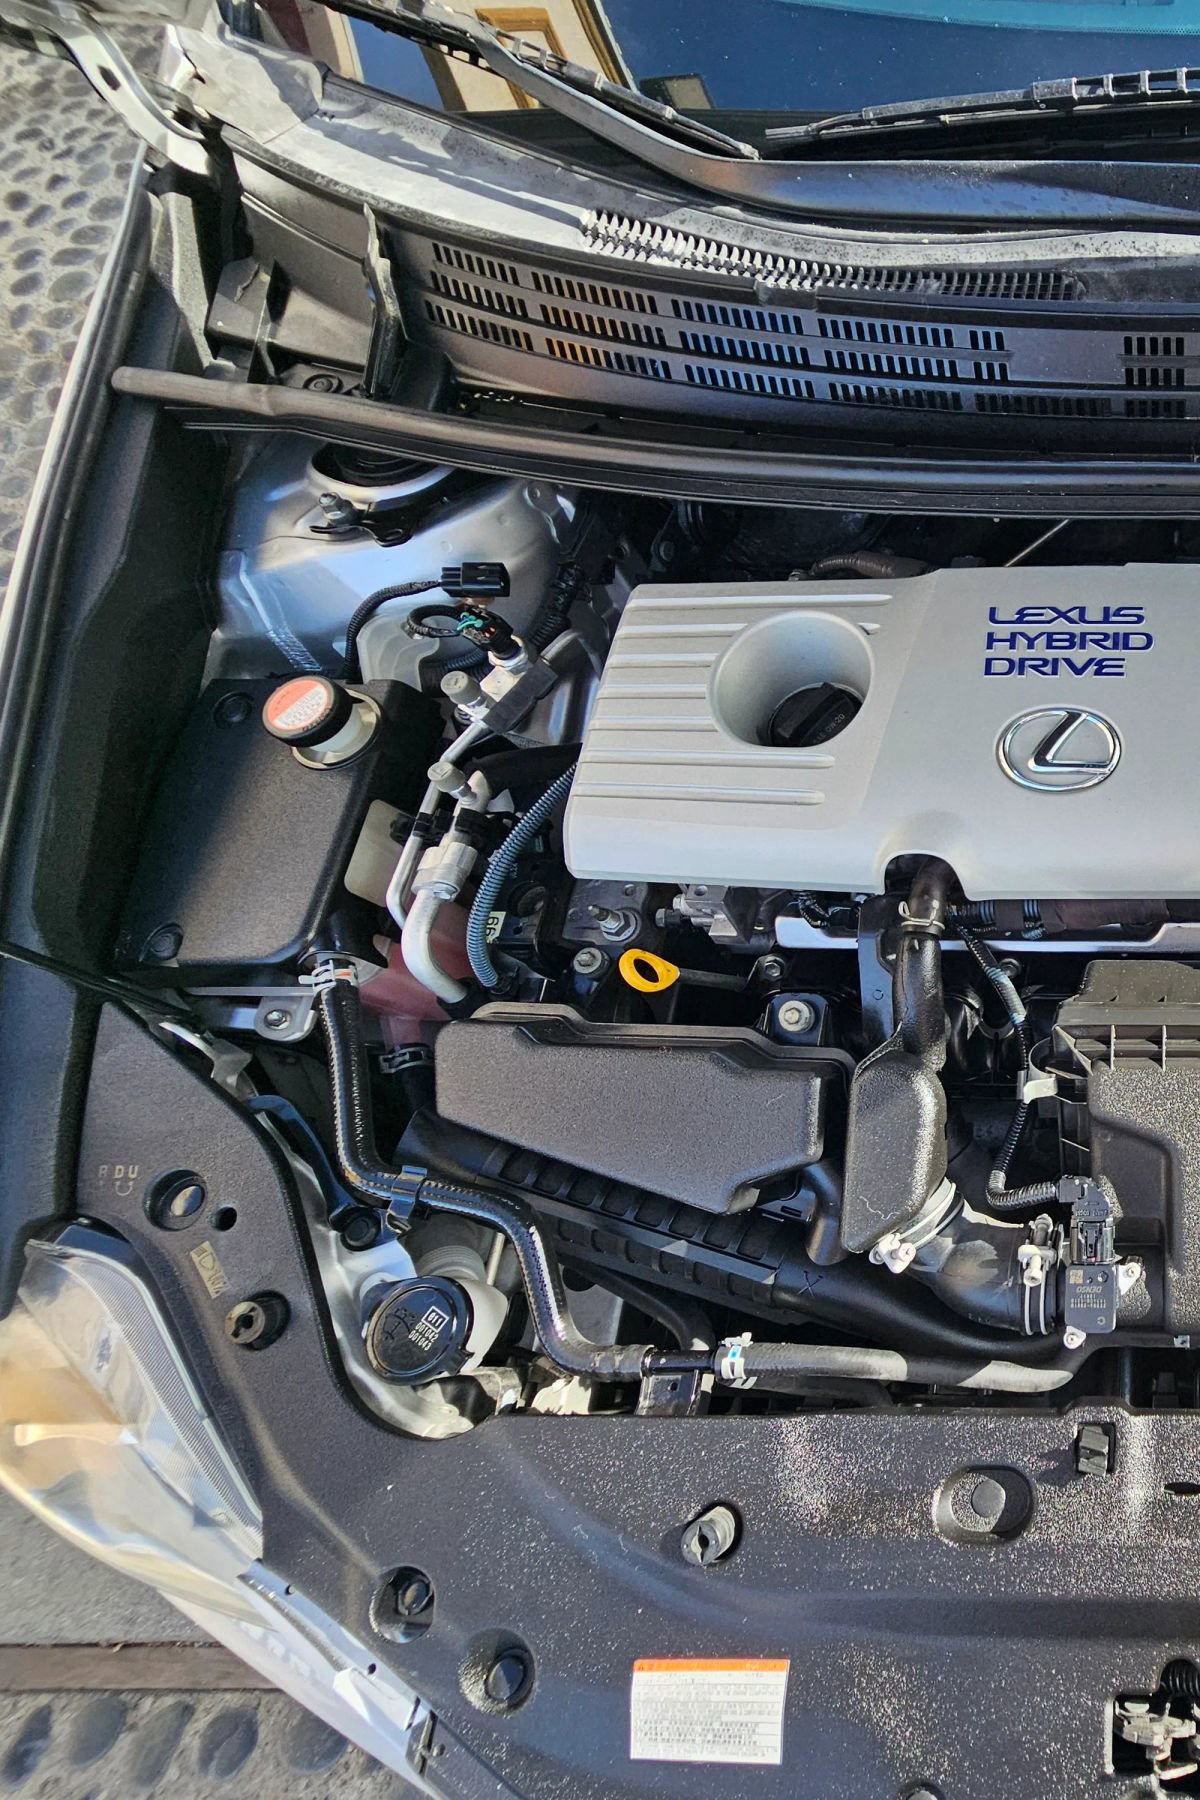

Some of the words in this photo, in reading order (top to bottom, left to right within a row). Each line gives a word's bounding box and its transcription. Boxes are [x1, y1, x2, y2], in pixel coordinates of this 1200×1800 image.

[988, 606, 1145, 625] LEXUS
[986, 632, 1154, 651] HYBRID
[984, 657, 1126, 677] DRIVE
[1076, 1286, 1103, 1294] DENSO
[408, 1330, 432, 1351] 001043
[415, 1322, 439, 1343] 001042
